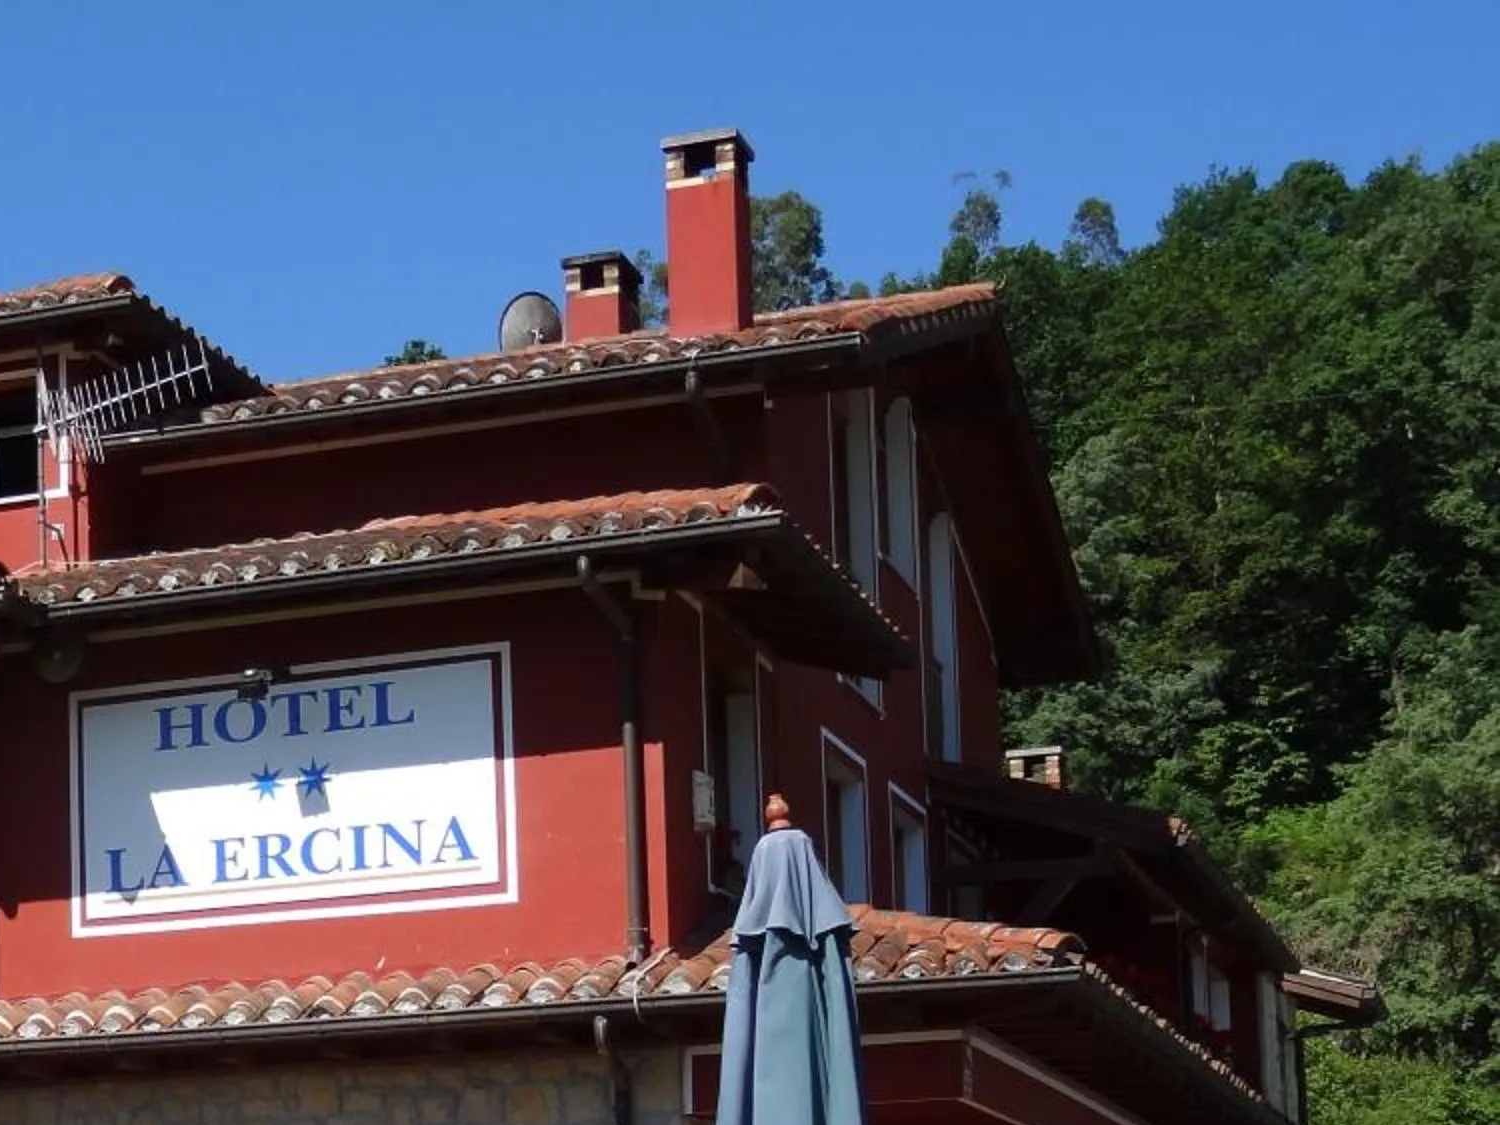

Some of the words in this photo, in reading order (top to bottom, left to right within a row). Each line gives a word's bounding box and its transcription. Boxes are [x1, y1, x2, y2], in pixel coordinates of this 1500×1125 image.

[154, 681, 415, 751] HOTEL
[105, 844, 188, 893] LA
[211, 816, 479, 883] ERCINA
